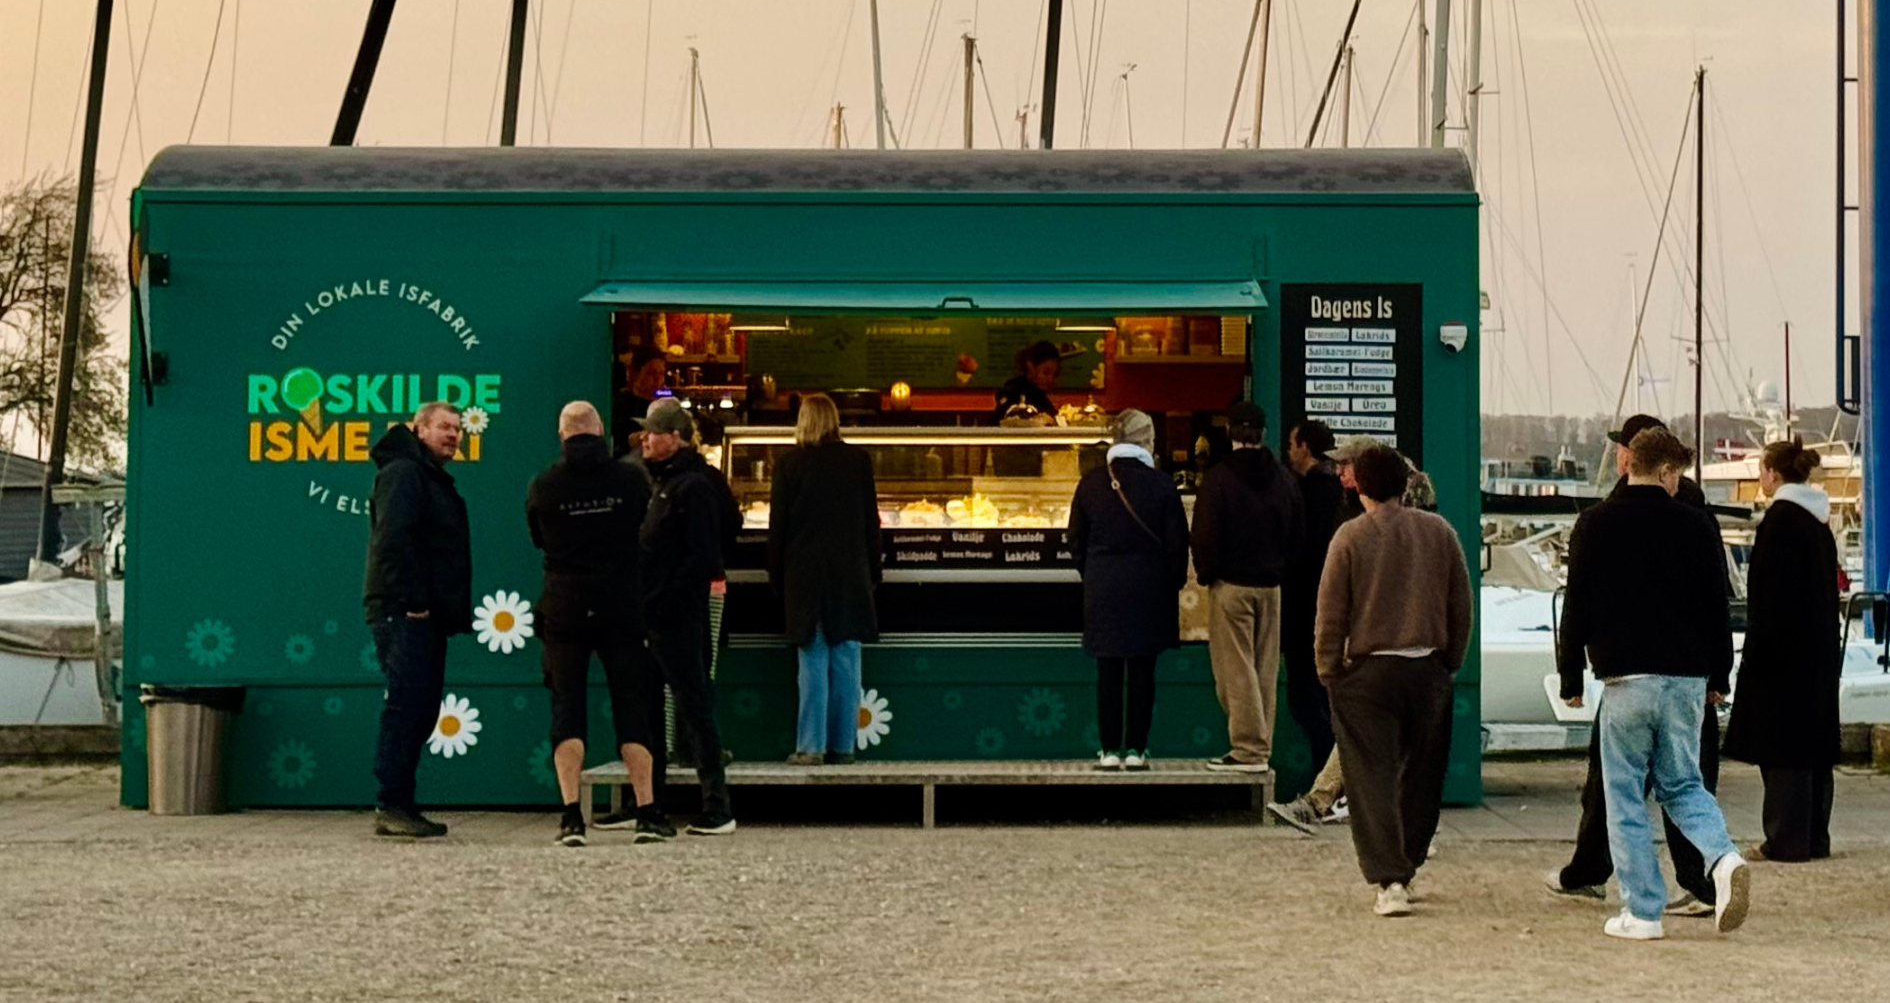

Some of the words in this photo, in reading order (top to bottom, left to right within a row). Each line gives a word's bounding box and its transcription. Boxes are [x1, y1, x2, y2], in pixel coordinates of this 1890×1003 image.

[271, 314, 303, 350] DIN
[305, 279, 390, 315] LOKALE
[399, 283, 480, 350] ISFABRIK
[1311, 296, 1372, 322] Dagens
[1377, 296, 1393, 319] Is
[1355, 331, 1390, 341] Lakrids
[1308, 365, 1345, 374] Jordbær
[248, 367, 501, 414] ROSKILDE
[1313, 381, 1344, 392] Lemon
[1311, 399, 1342, 411] Vanilje
[1362, 399, 1387, 409] Oreo
[1340, 417, 1388, 428] Chokolade
[249, 421, 481, 462] ISMEI
[309, 480, 330, 504] VI
[952, 531, 985, 544] Vanilje
[1001, 532, 1045, 544] Chokolade
[1004, 551, 1041, 562] Lakrids
